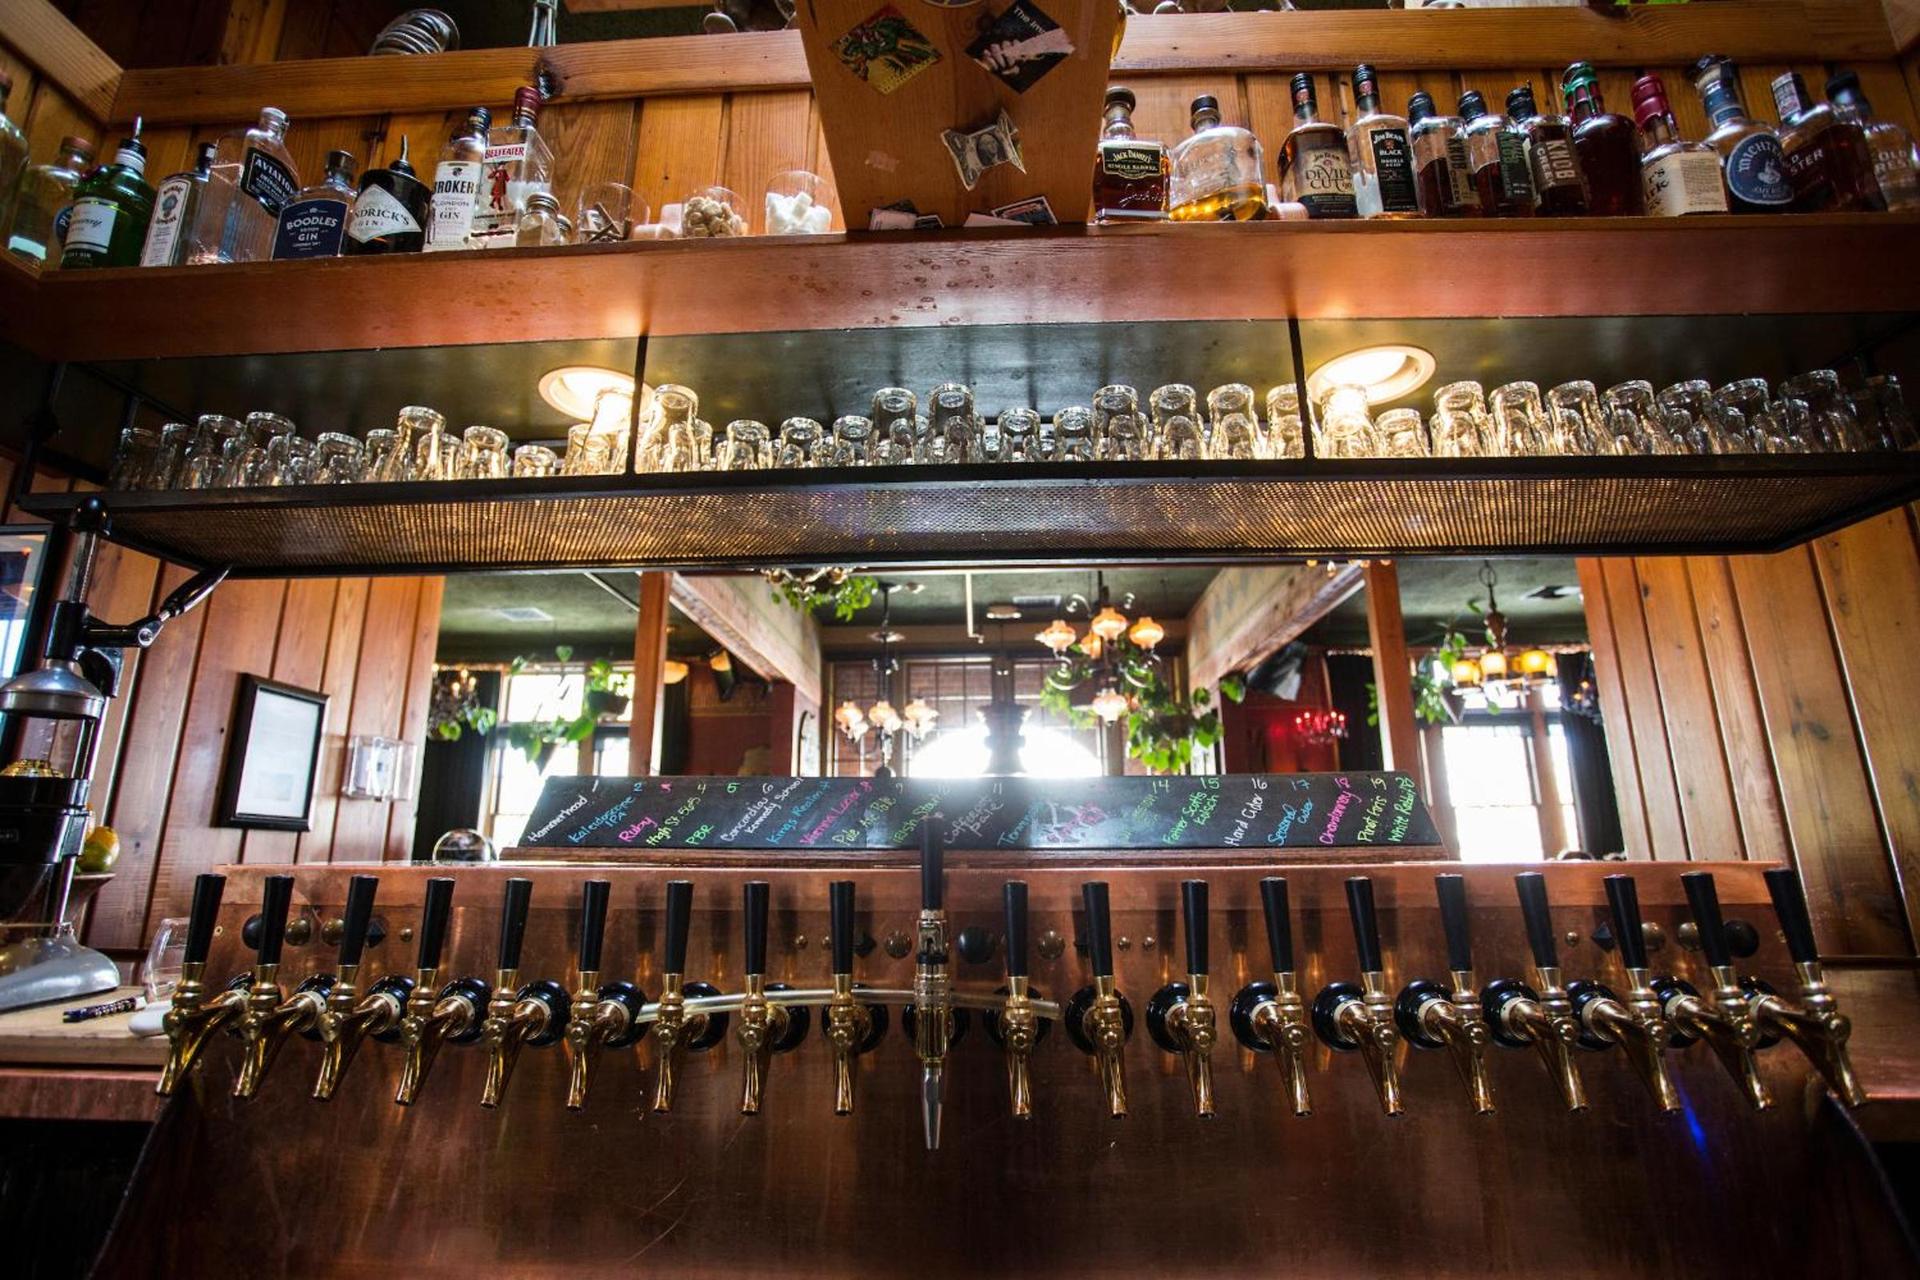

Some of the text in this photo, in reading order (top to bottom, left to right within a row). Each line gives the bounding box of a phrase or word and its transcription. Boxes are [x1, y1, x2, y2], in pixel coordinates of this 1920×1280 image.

[1536, 147, 1557, 187] CREEK
[1545, 140, 1578, 179] KNOB
[286, 216, 339, 230] BOODLES
[297, 232, 318, 241] GIN
[633, 782, 643, 792] 2
[697, 783, 706, 794] 4
[762, 782, 774, 794] 6
[1153, 779, 1169, 794] 14
[1252, 777, 1268, 790] 16
[1370, 777, 1387, 790] 19
[605, 811, 628, 828] IPA
[618, 816, 658, 842] Ruby
[646, 826, 672, 846] High
[685, 824, 714, 845] PBR
[1223, 819, 1249, 847] Hard
